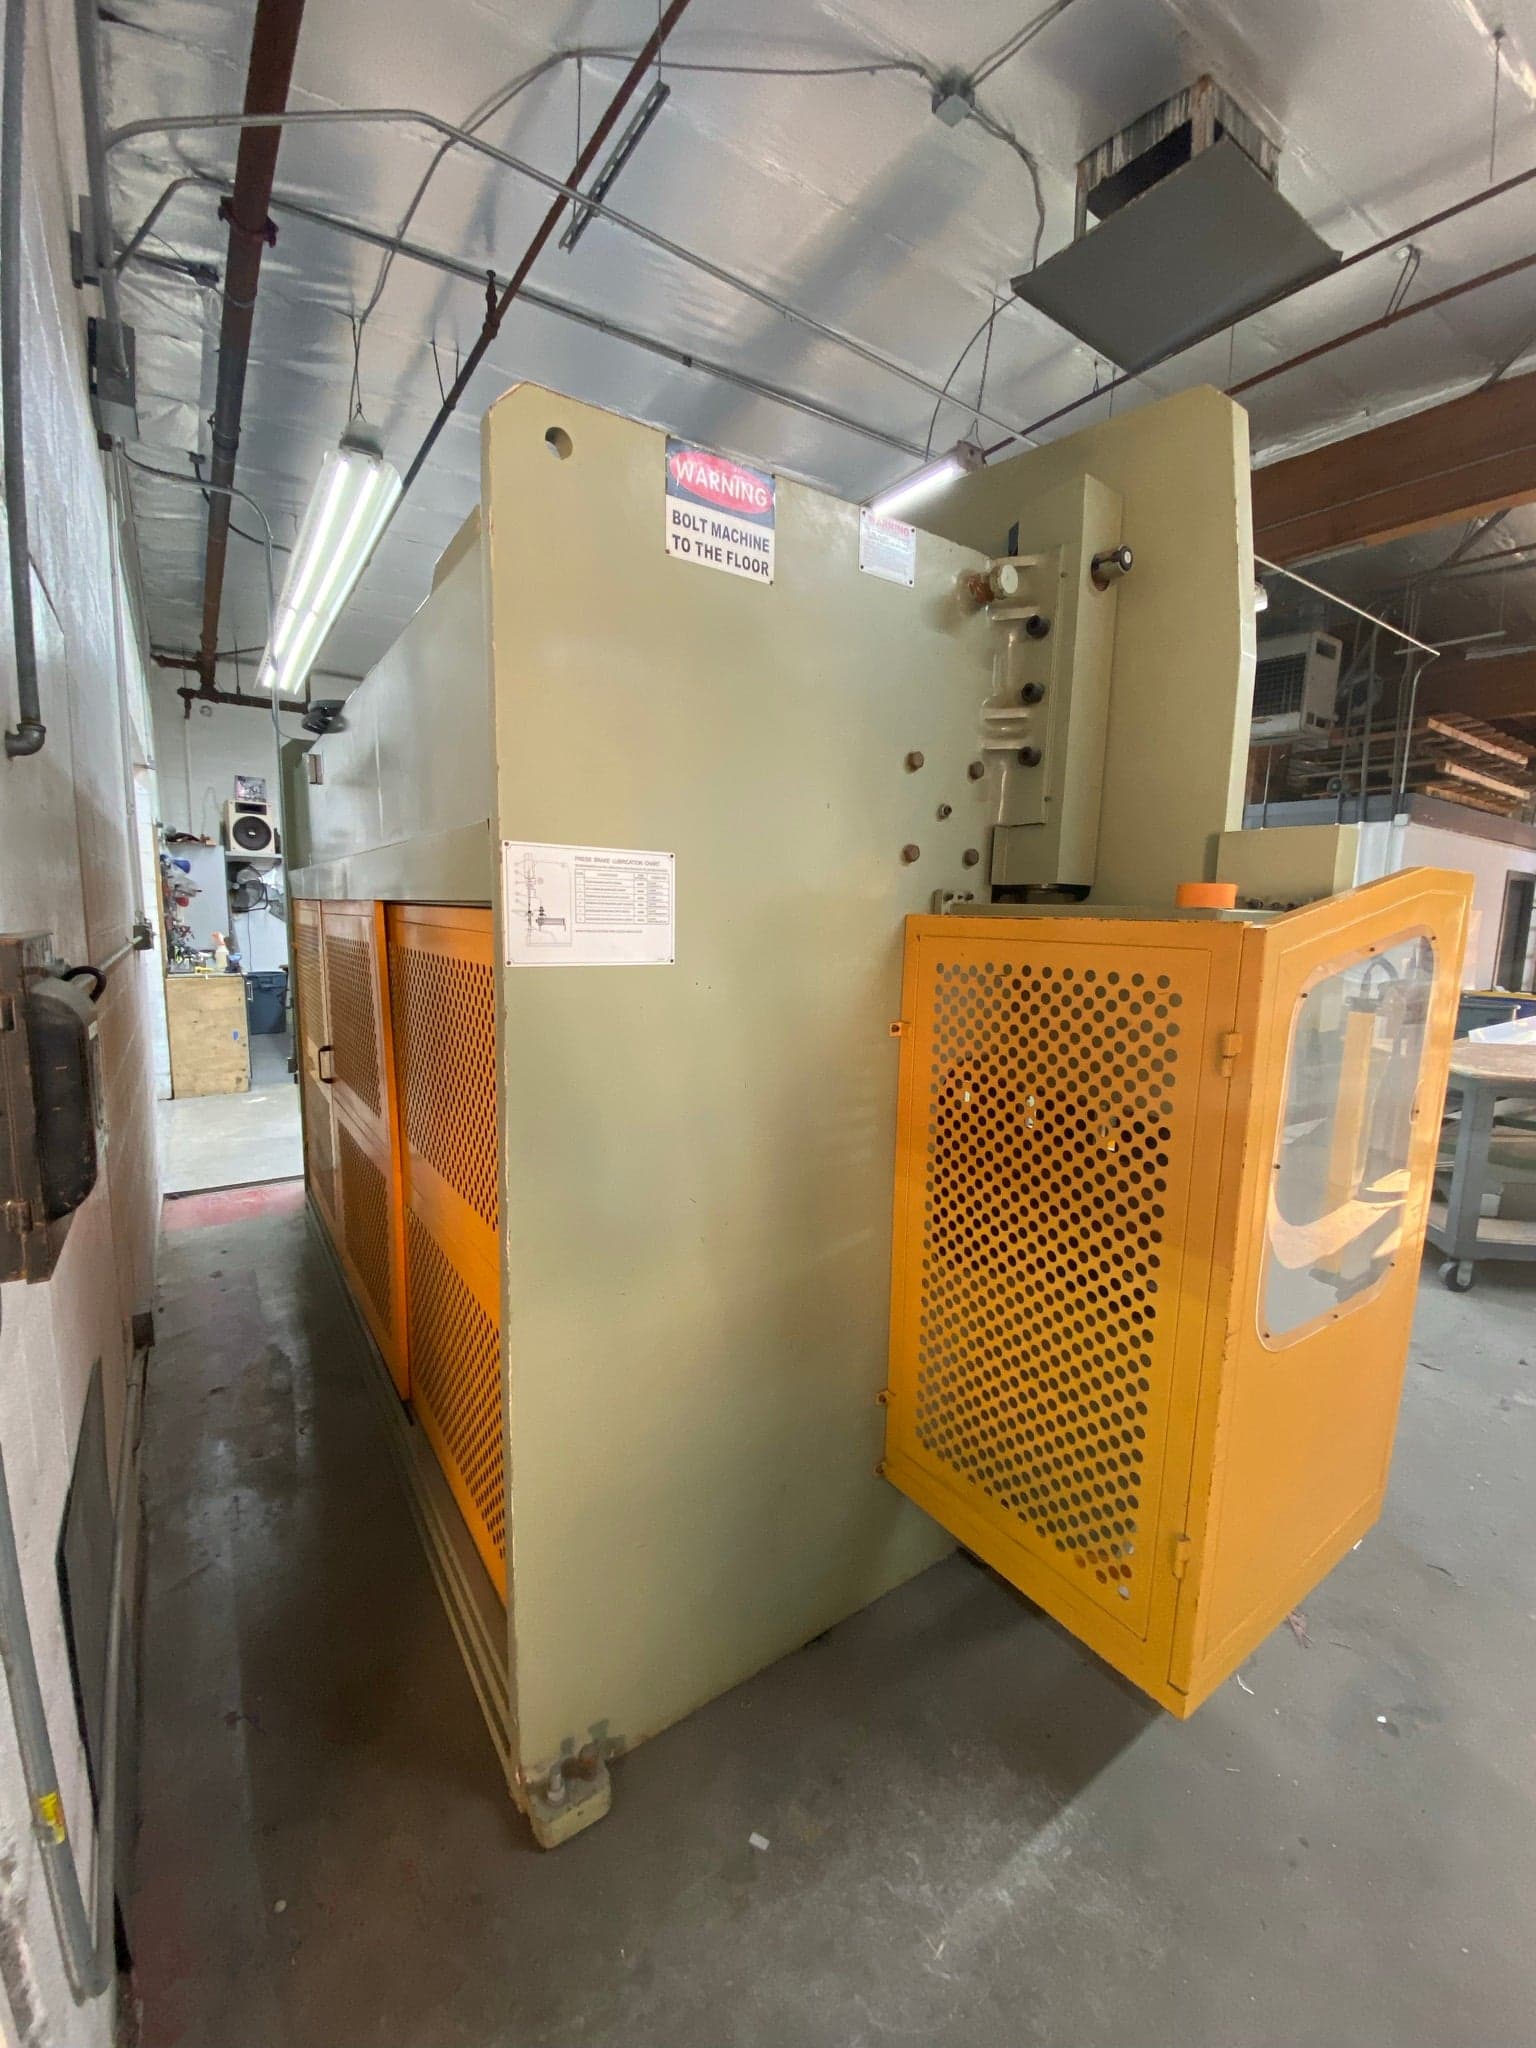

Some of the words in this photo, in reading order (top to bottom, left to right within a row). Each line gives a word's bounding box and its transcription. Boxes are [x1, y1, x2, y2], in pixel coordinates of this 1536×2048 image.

[676, 457, 768, 507] WARNING
[672, 509, 708, 533] BOLT
[711, 522, 770, 553] MACHINE
[672, 534, 691, 553] TO
[695, 541, 722, 562] THE
[726, 551, 769, 576] FLOOR
